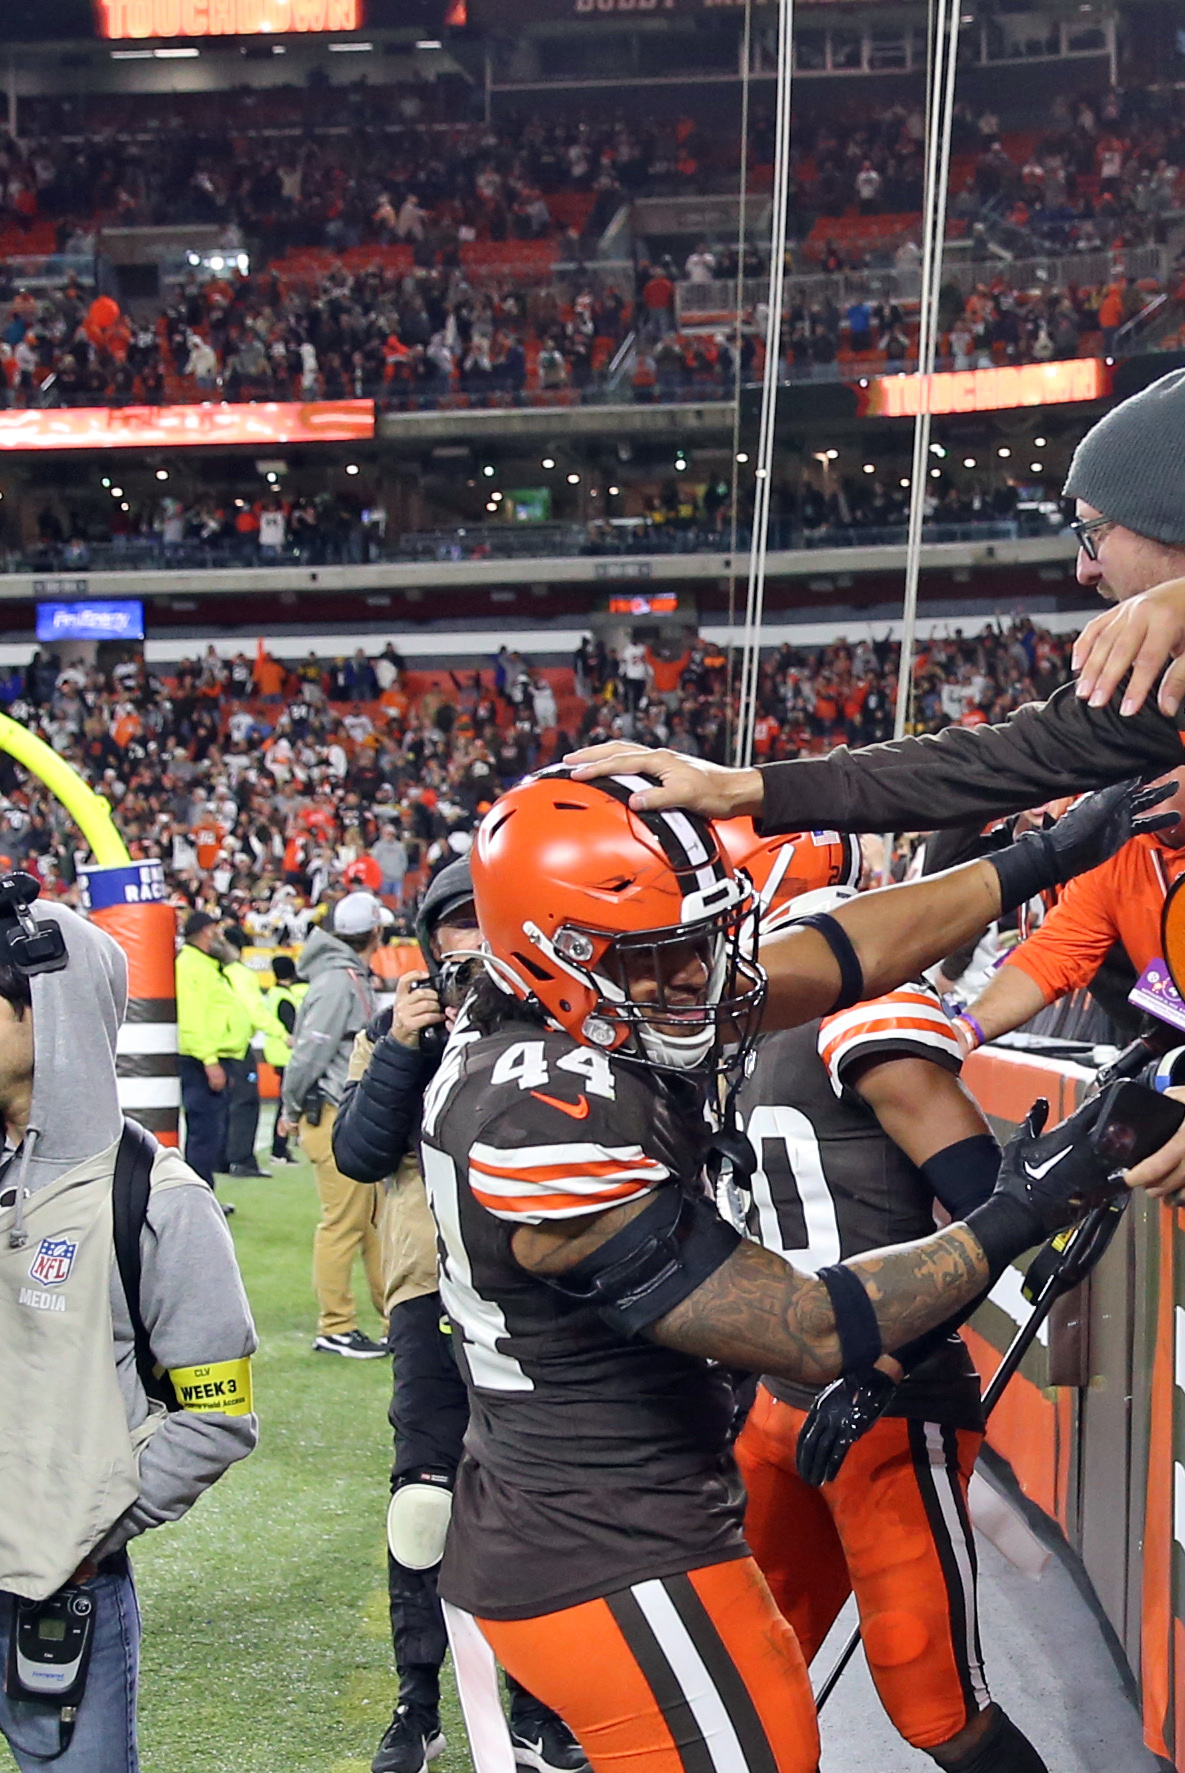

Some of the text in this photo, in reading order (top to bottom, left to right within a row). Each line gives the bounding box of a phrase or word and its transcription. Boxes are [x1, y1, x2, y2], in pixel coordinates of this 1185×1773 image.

[491, 1041, 617, 1100] 44
[33, 1255, 67, 1280] NFL
[19, 1287, 67, 1312] MEDIA
[194, 1368, 210, 1377] CLV
[180, 1379, 237, 1402] WEEK 3
